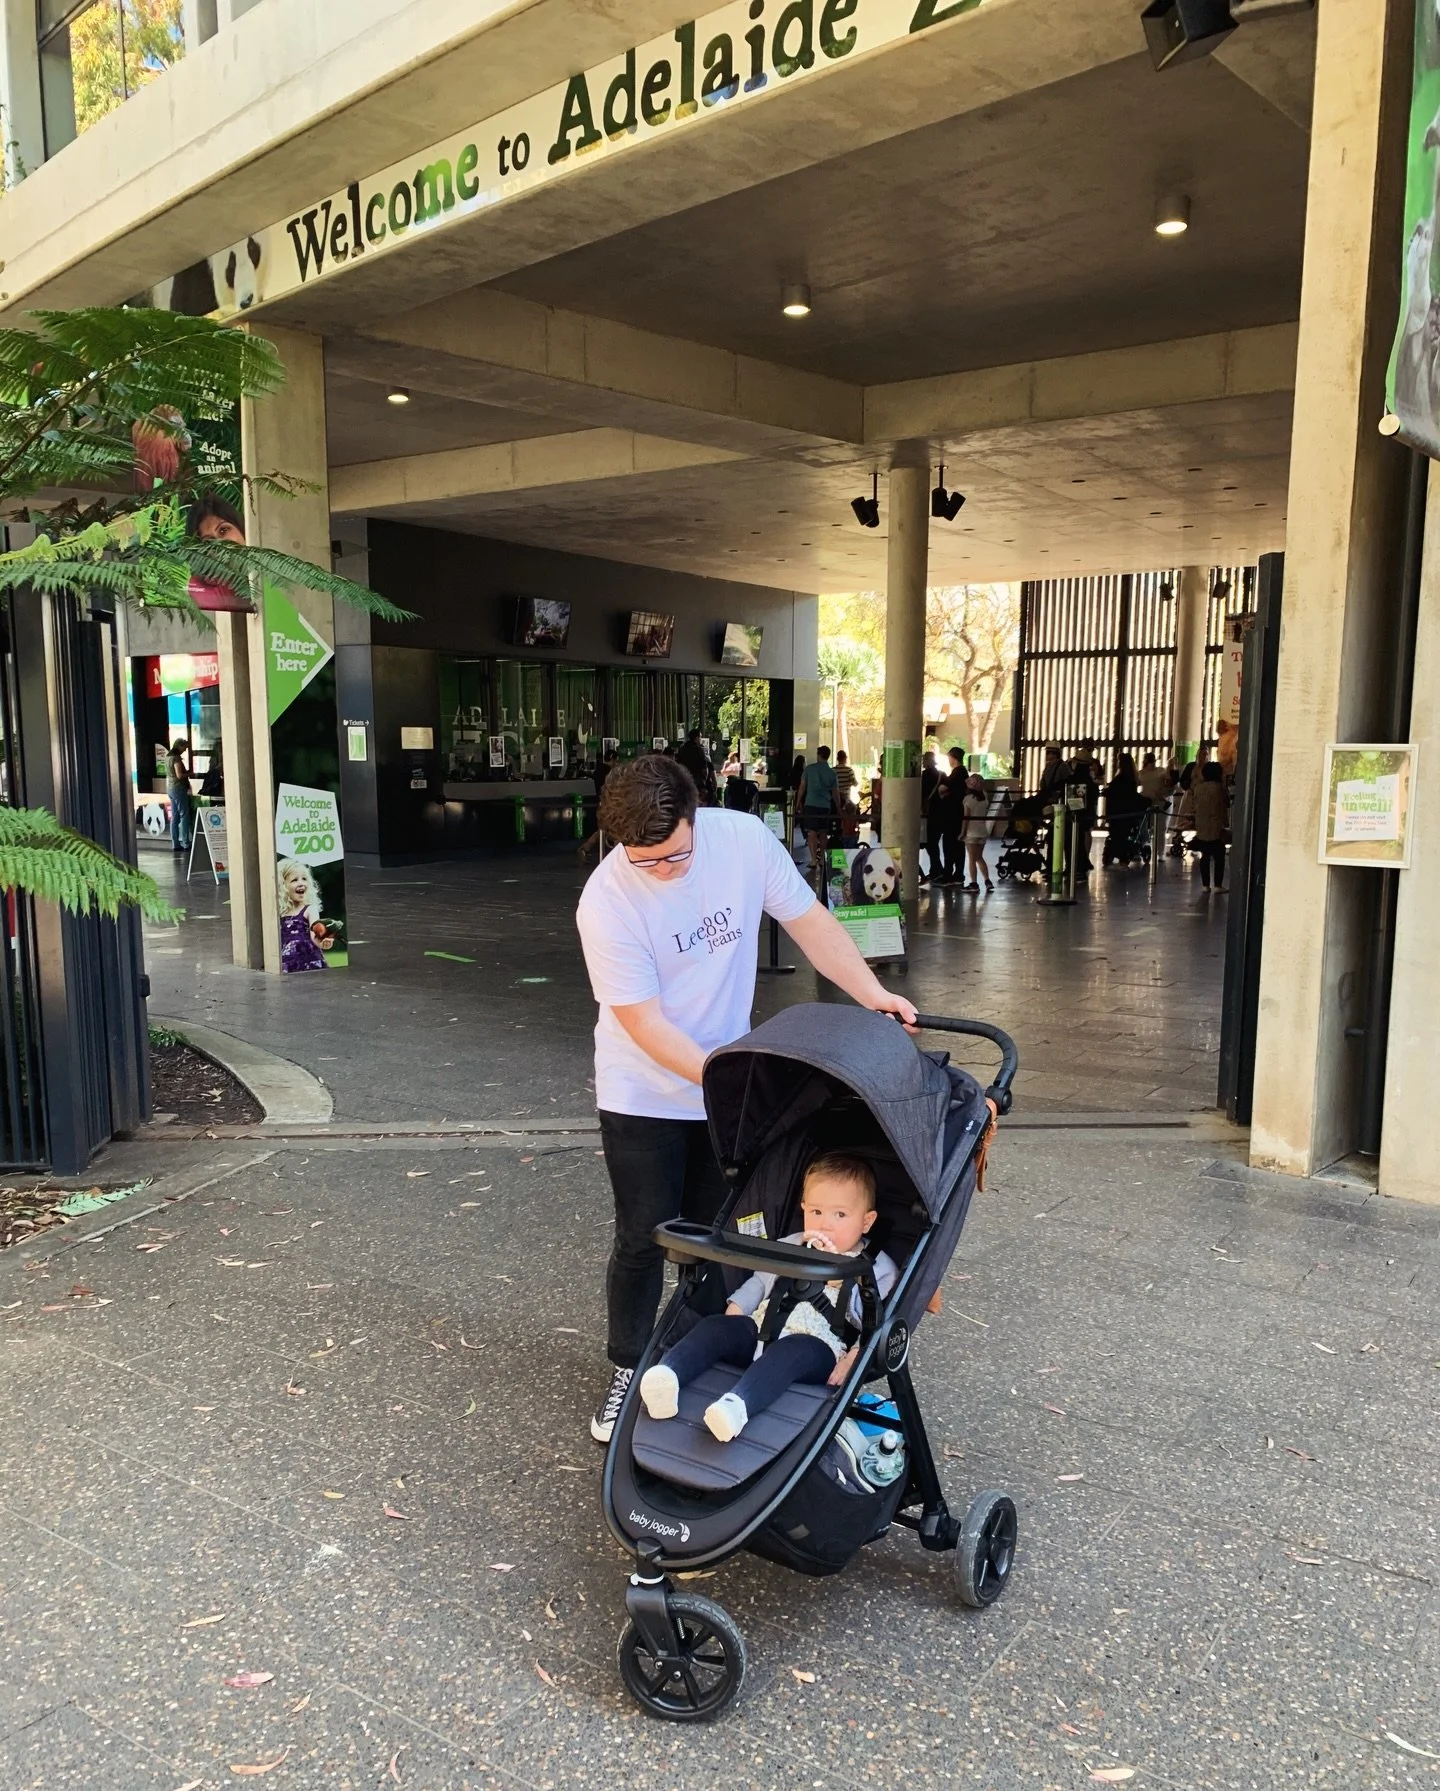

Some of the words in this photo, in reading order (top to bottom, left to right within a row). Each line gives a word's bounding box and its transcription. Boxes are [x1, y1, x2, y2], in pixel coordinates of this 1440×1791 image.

[287, 143, 480, 282] Welcome
[497, 132, 530, 176] to
[548, 0, 857, 165] Adelaide
[200, 442, 231, 461] Adopt
[197, 462, 236, 474] animal
[270, 632, 317, 656] Enter
[276, 653, 308, 672] here
[452, 705, 566, 728] ADLAIE
[282, 796, 332, 809] Welcome
[309, 810, 320, 818] to
[280, 817, 336, 834] Adelaide
[707, 928, 742, 954] jeans
[629, 1510, 650, 1528] baby
[647, 1519, 680, 1537] jogger
